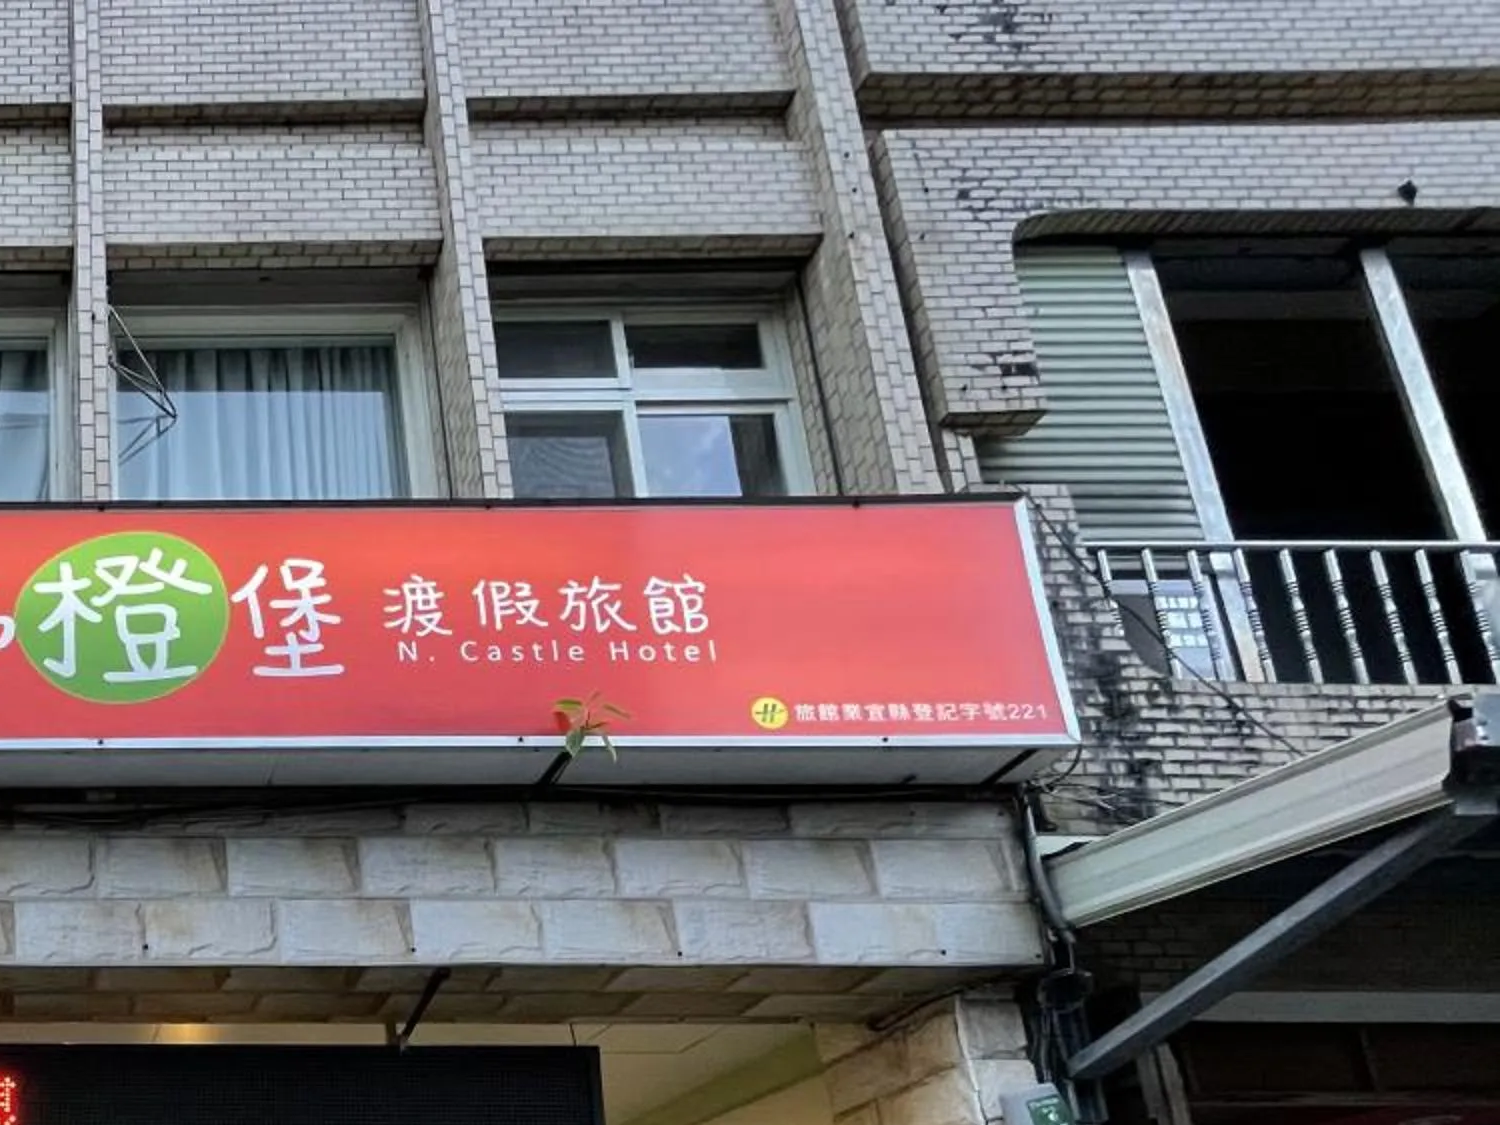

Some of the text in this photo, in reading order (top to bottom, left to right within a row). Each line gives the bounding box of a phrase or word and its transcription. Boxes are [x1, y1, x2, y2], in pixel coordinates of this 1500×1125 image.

[382, 573, 710, 638] 渡假旅館
[398, 638, 718, 663] N. Castle Hotel
